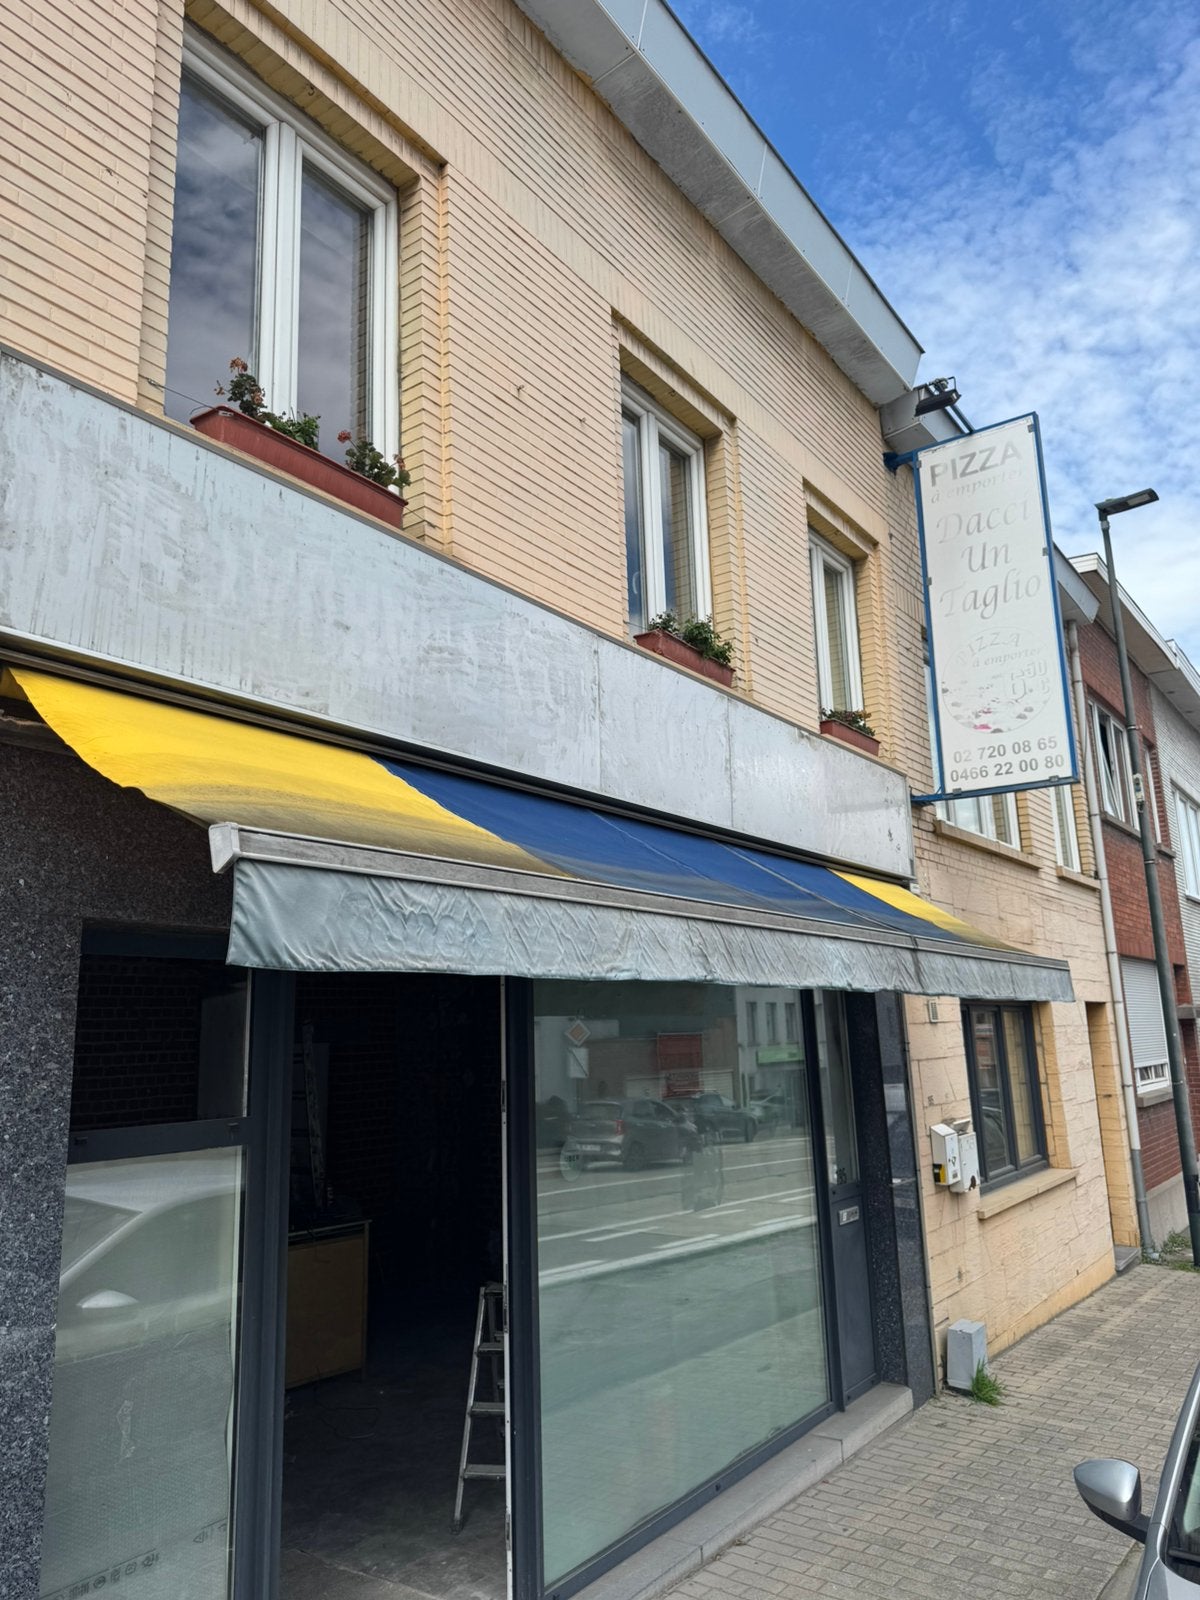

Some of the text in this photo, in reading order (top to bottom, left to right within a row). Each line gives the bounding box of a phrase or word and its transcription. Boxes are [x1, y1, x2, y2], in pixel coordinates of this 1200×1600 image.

[930, 441, 1023, 487] PIZZA
[961, 542, 1012, 573] Un
[939, 568, 1041, 620] Taglio
[953, 736, 1058, 764] 02 720 08 65
[950, 754, 1064, 782] 0466 22 00 80
